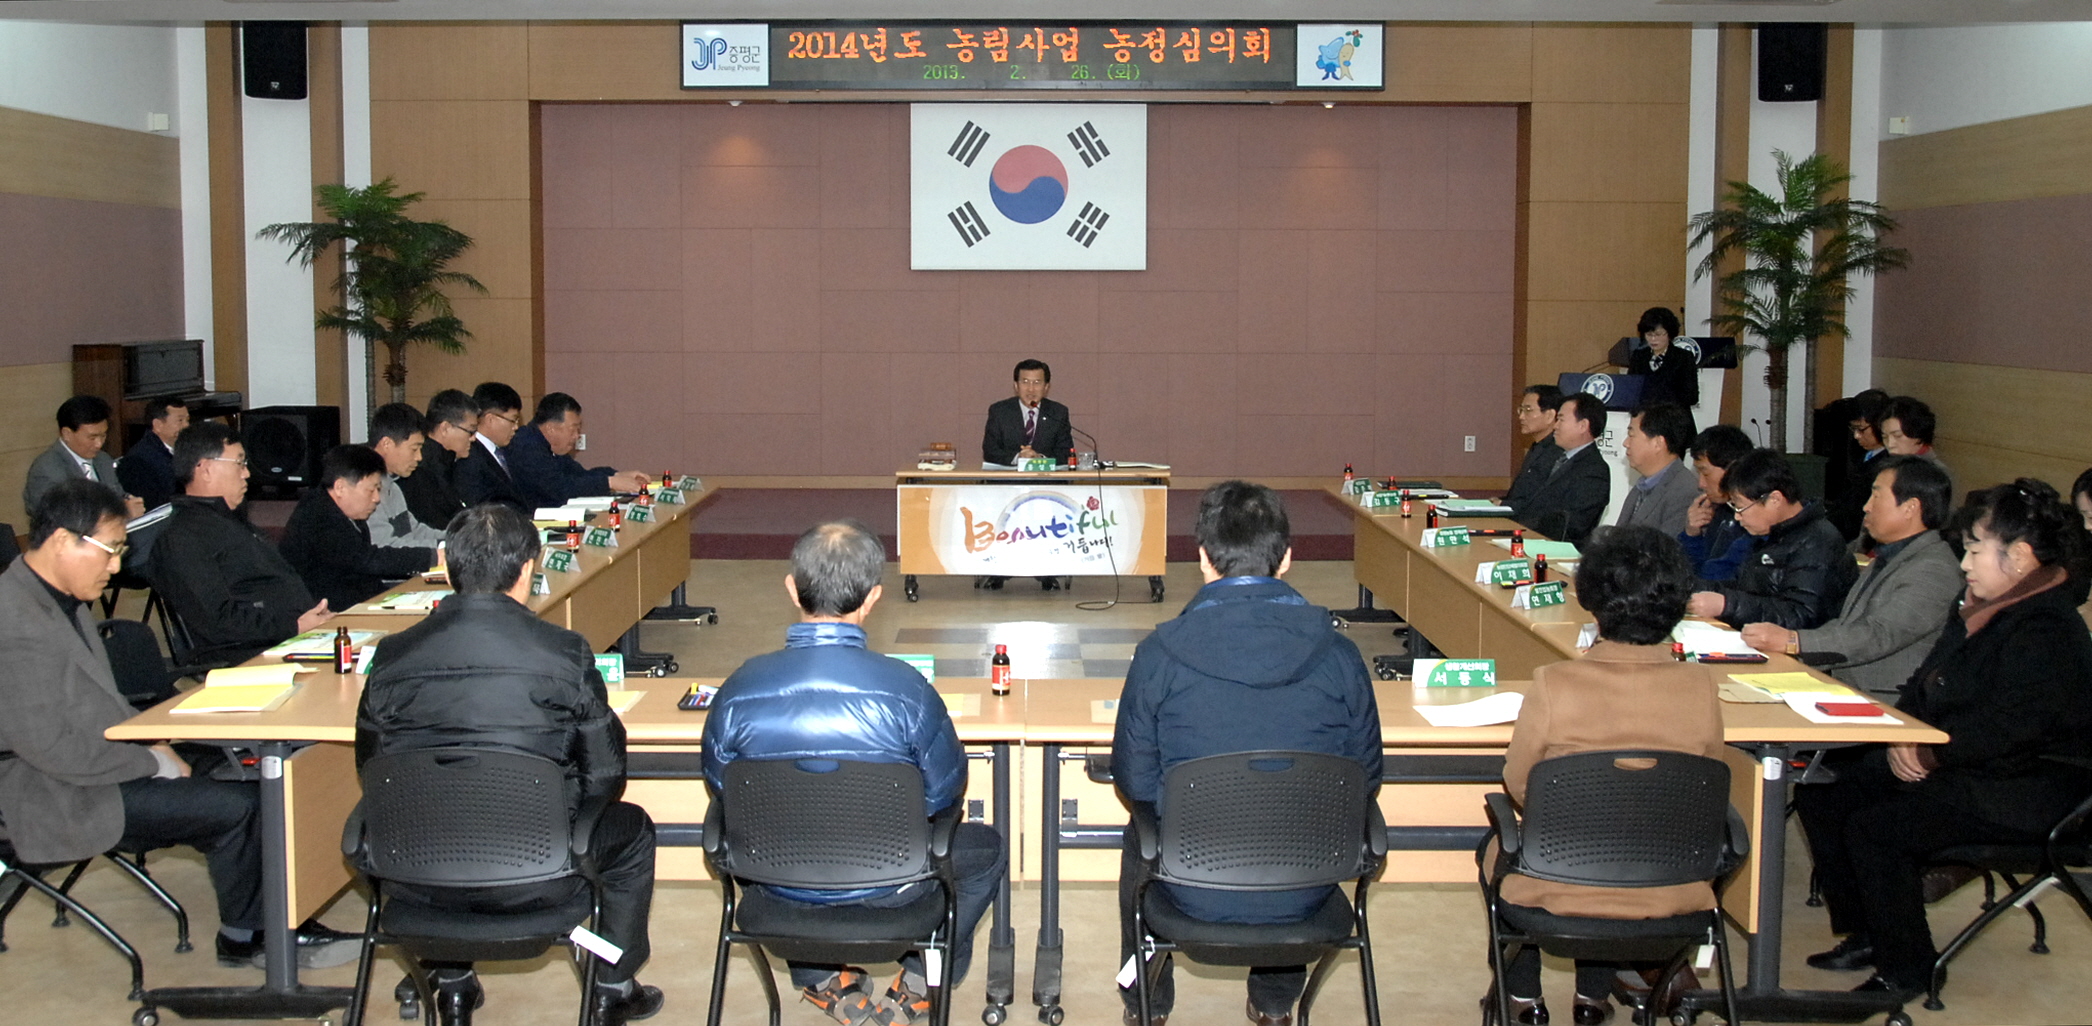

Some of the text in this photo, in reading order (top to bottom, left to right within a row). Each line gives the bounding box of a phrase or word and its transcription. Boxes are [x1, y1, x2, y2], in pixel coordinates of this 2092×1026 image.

[729, 46, 760, 63] 증평군
[788, 27, 1270, 63] 2014년도 농림사업 농정심의회
[923, 64, 1140, 80] 2013. 2. 26. (화)
[960, 506, 1118, 553] Beautiful
